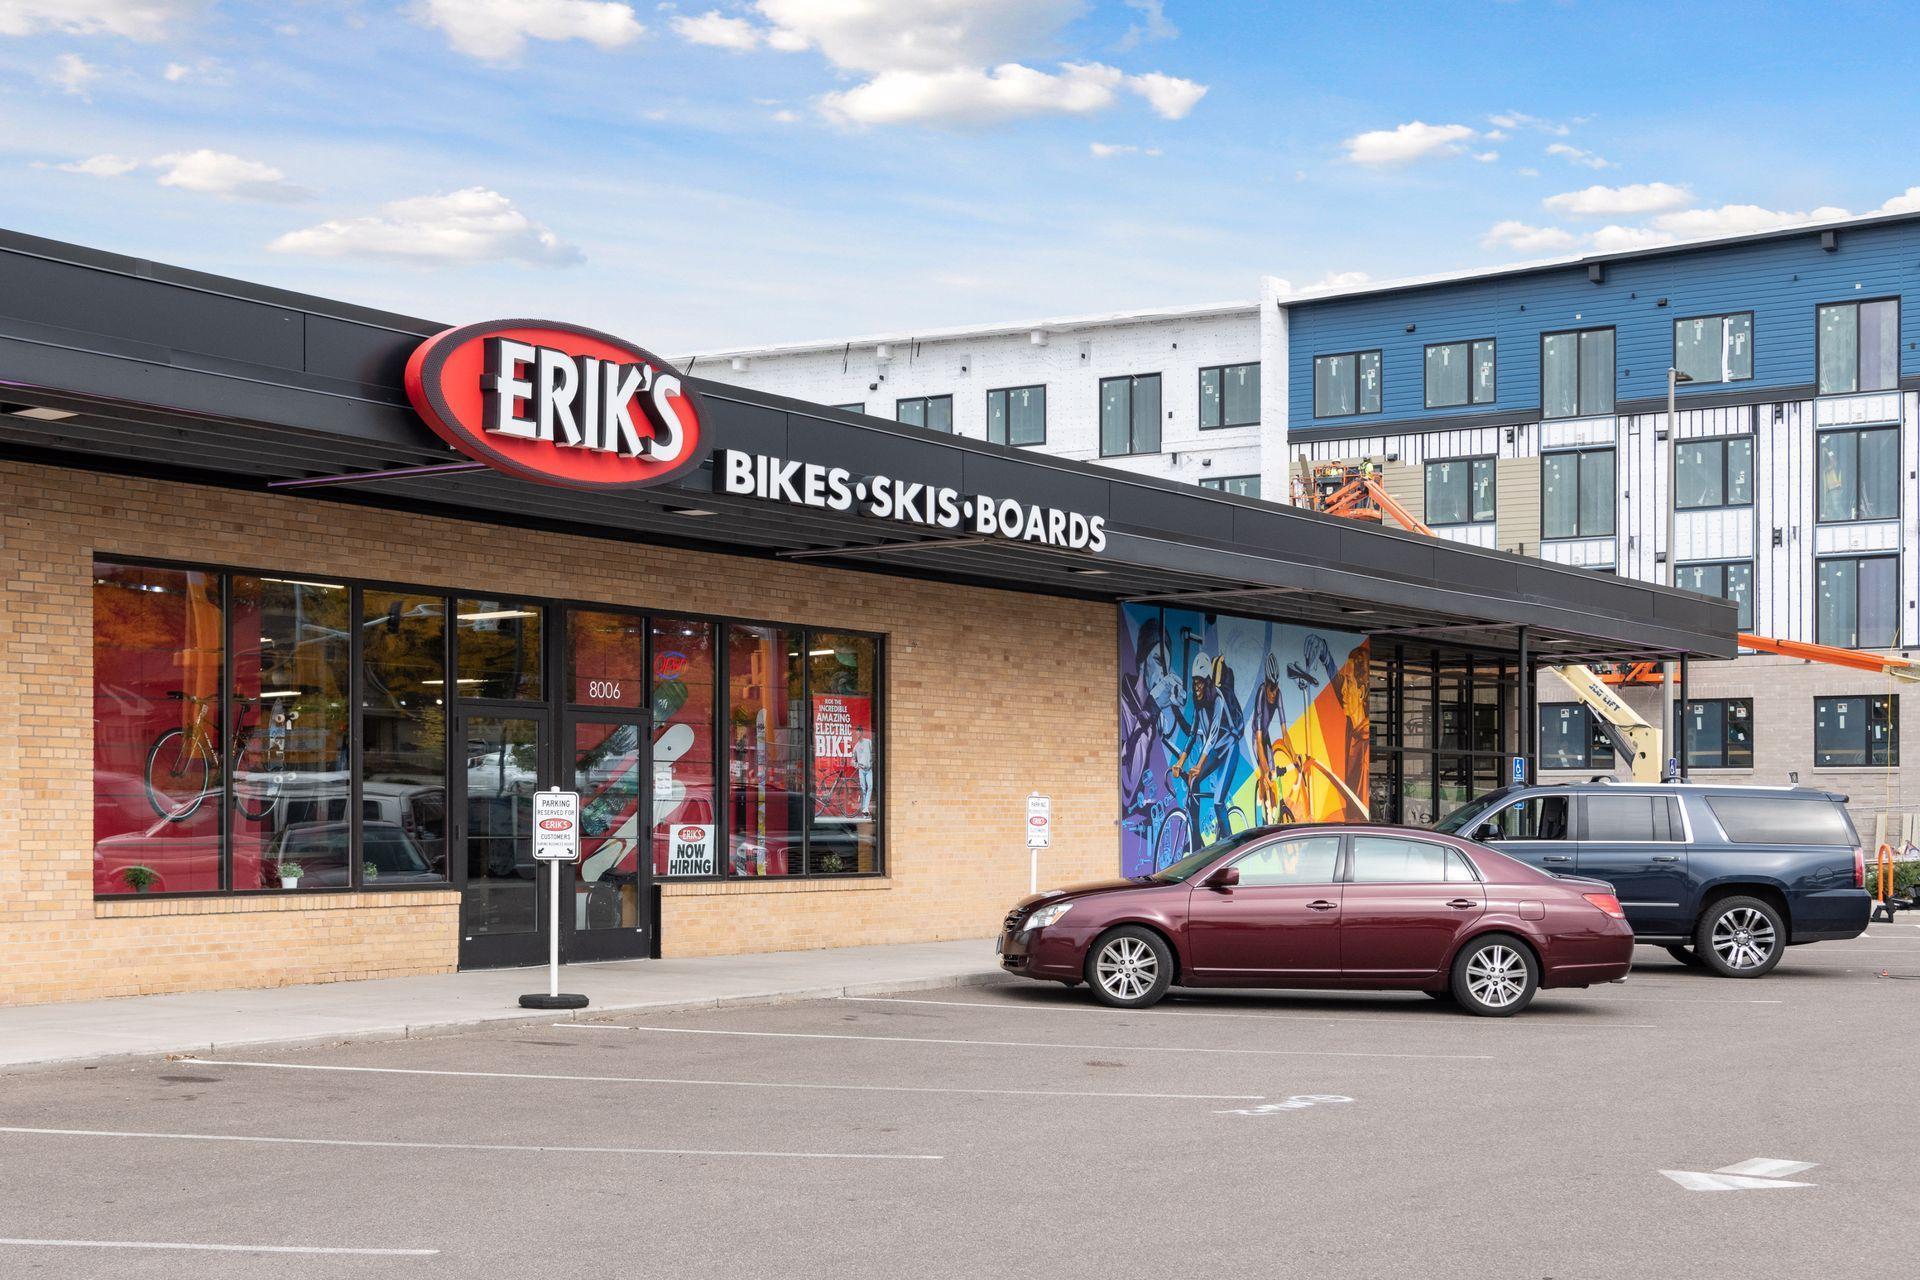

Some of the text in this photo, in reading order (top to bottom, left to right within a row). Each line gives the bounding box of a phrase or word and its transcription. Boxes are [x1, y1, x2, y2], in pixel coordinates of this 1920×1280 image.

[498, 338, 684, 462] ERIK'S
[726, 449, 1107, 553] BIKES SKIS BOARDS
[589, 681, 621, 699] 8006
[818, 704, 848, 713] INCREDIBLE
[1603, 696, 1621, 711] LIFT
[816, 713, 851, 723] AMAZING
[815, 722, 852, 736] ELECTRIC
[677, 844, 706, 859] NOW
[670, 859, 711, 874] HIRING
